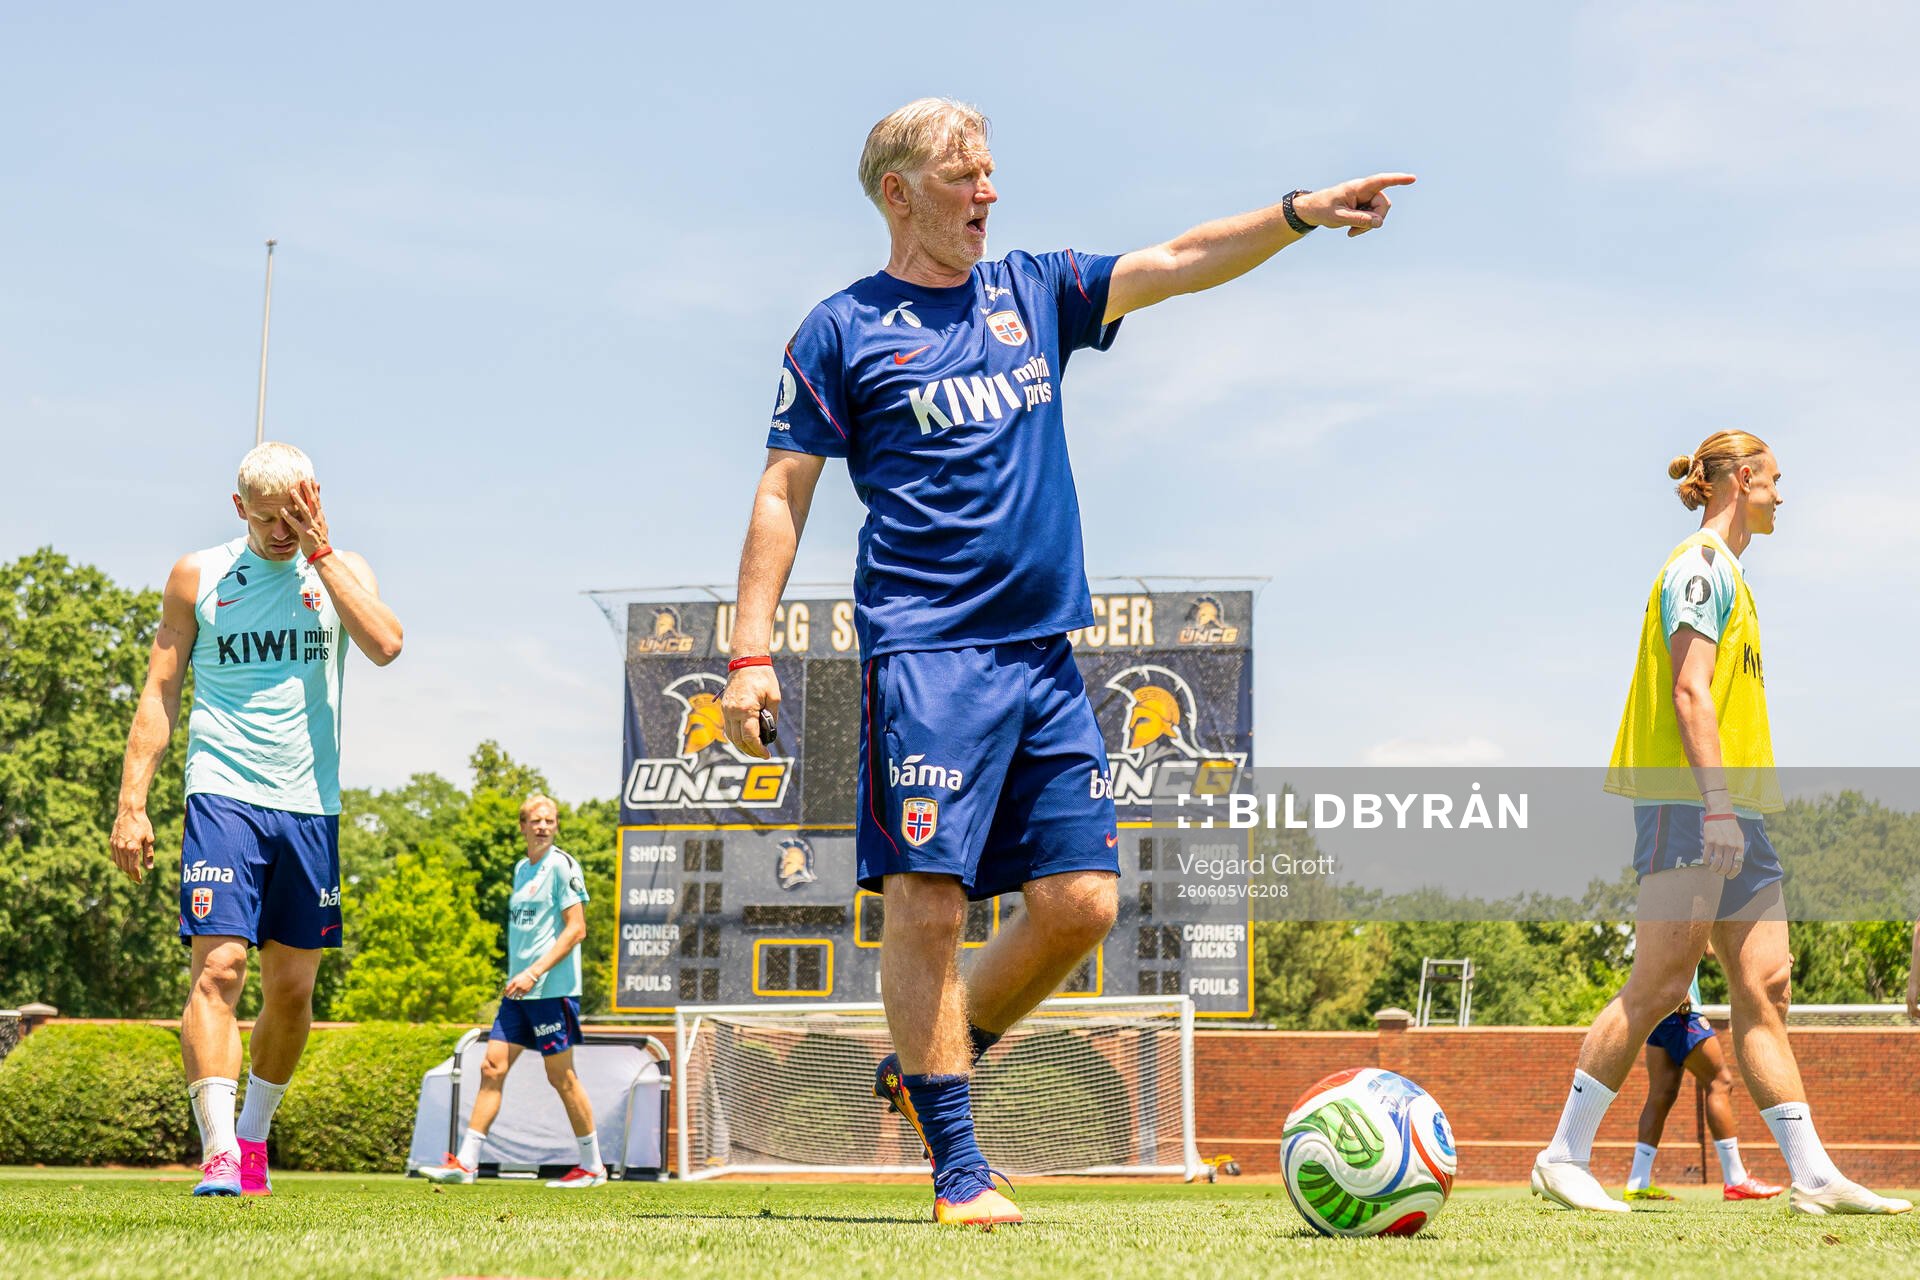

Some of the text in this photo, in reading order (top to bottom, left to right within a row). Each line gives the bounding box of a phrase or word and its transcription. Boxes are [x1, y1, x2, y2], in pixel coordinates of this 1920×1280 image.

[1012, 352, 1050, 384] mini
[1022, 377, 1052, 412] pris
[908, 372, 1022, 436] KIWI
[304, 627, 333, 643] mini
[716, 602, 811, 653] UCG
[1178, 626, 1239, 645] UNCG
[217, 629, 298, 665] KIWI
[304, 644, 329, 664] pris
[629, 763, 787, 802] UNCG
[629, 845, 677, 862] SHOTS
[628, 888, 675, 905] SAVES
[622, 923, 680, 940] CORNER
[1183, 924, 1246, 942] CORNER
[628, 940, 670, 956] KICKS
[1191, 942, 1238, 959] KICKS
[625, 975, 672, 992] FOULS
[1189, 977, 1239, 995] FOULS
